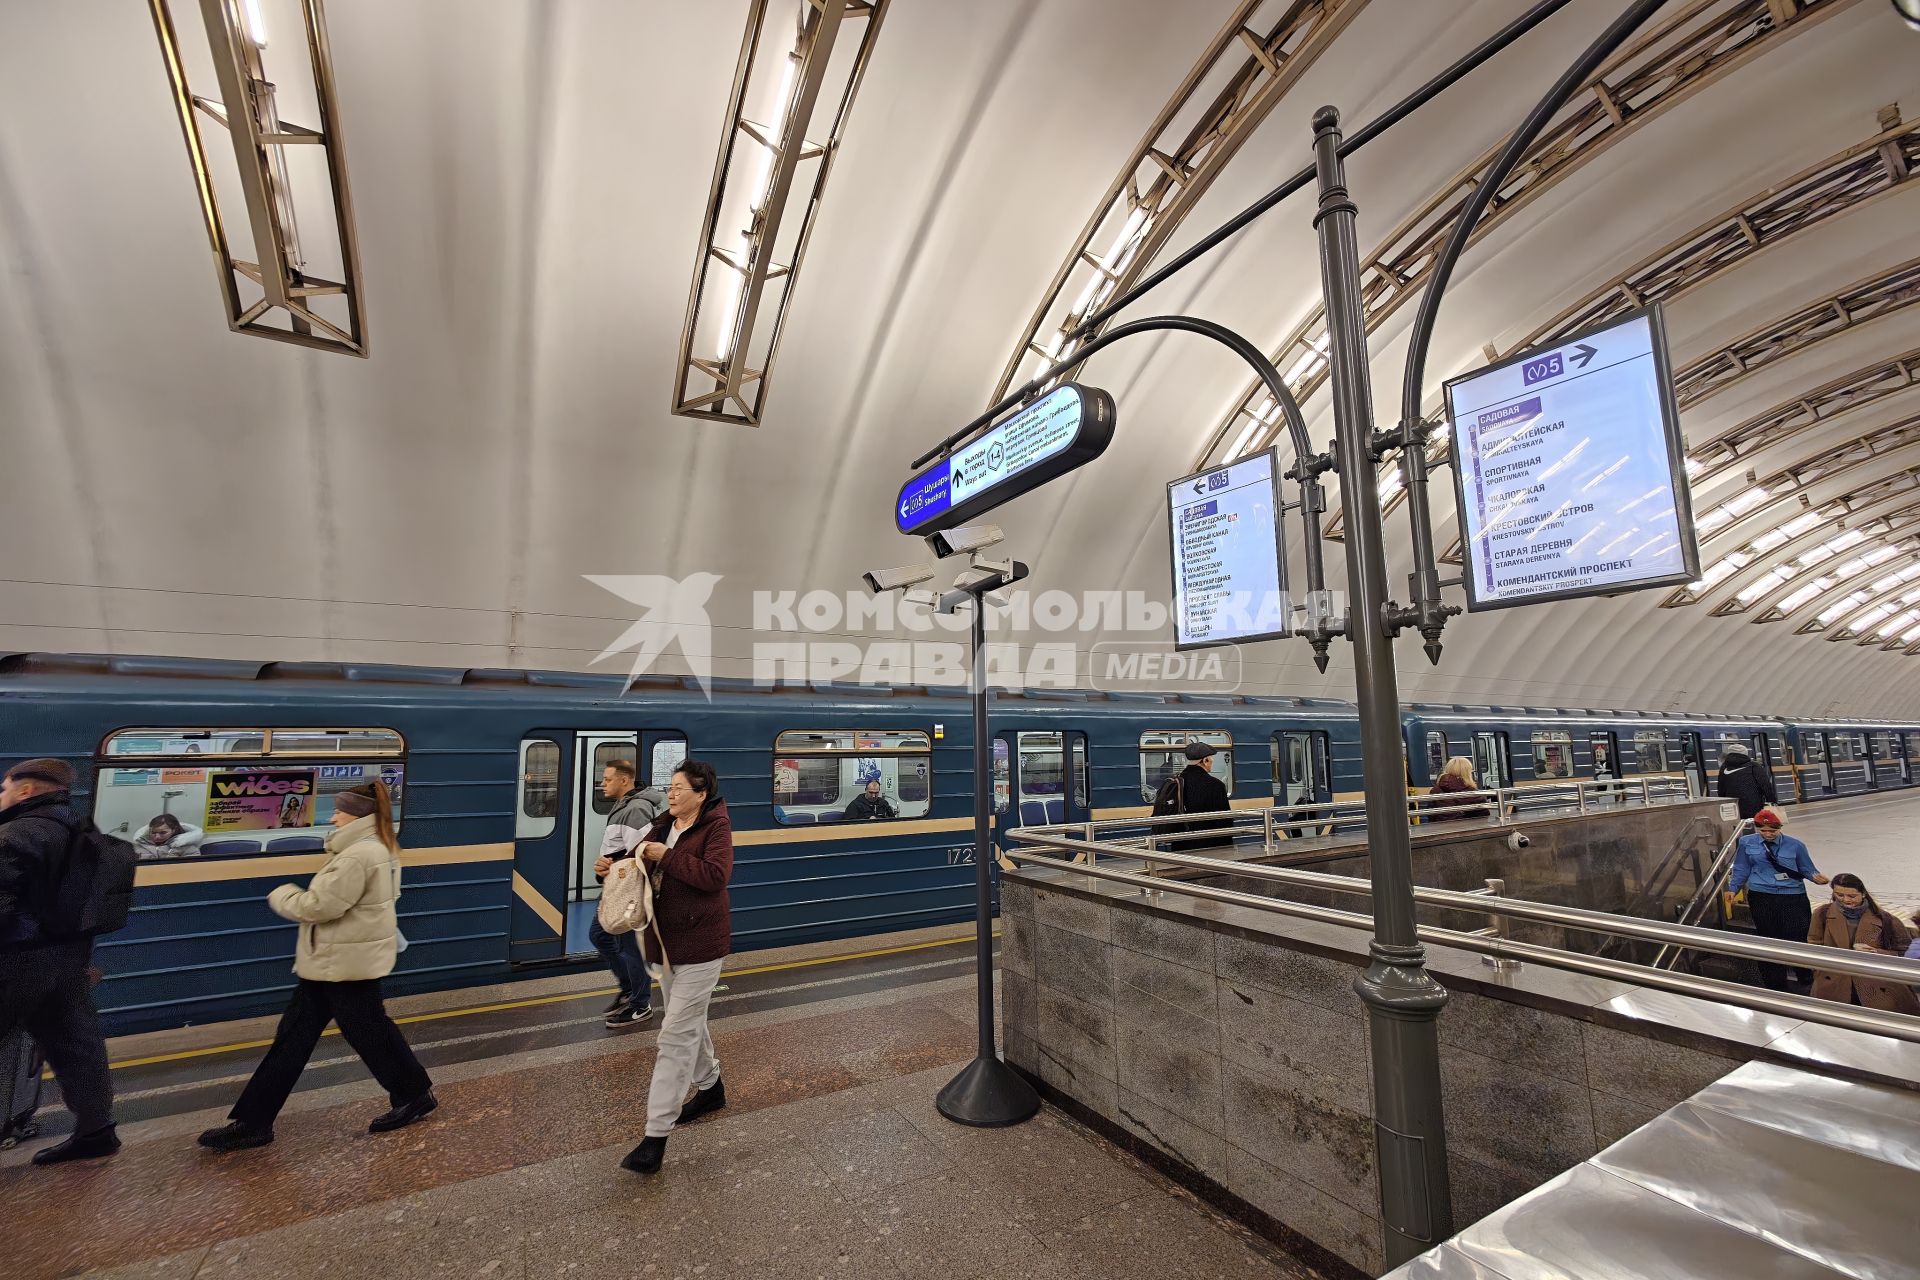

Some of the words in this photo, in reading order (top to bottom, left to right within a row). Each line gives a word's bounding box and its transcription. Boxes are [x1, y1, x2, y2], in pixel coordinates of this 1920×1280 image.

[1549, 357, 1560, 373] 5
[1480, 405, 1520, 424] САДОВАЯ
[1481, 420, 1565, 451] АДМИАЛТЕЙСКАЯ
[964, 449, 986, 466] Выходы
[1482, 438, 1544, 460] MIRALTEYSKAYA
[969, 459, 985, 472] город
[1484, 456, 1542, 478] СПОРТИВНАЯ
[965, 475, 977, 486] Ways
[978, 469, 987, 479] out
[1222, 474, 1227, 485] 5
[1486, 470, 1530, 486] SPORTIVNAYA
[918, 494, 923, 506] 5
[924, 489, 947, 507] Shushary
[1487, 484, 1545, 503] ЧКАЛОВСКАЯ
[1489, 496, 1539, 512] CHKAOVSKAYA
[1491, 510, 1553, 532] КРЕСТОВСКИЙ
[1492, 527, 1535, 541] KRESTOVSKIY
[1537, 520, 1565, 532] STROV
[1494, 546, 1528, 560] СТАРАЯ
[1530, 538, 1573, 555] ДЕРЕВНЯ
[1496, 558, 1525, 569] STARAYA
[1525, 552, 1561, 564] DEREVNYA
[1497, 567, 1577, 588] КОМЕНДАНТСКИЙ
[1580, 559, 1633, 575] ПРОСПЕКТ
[1555, 577, 1593, 589] PROSPEKT
[947, 848, 976, 865] 172
